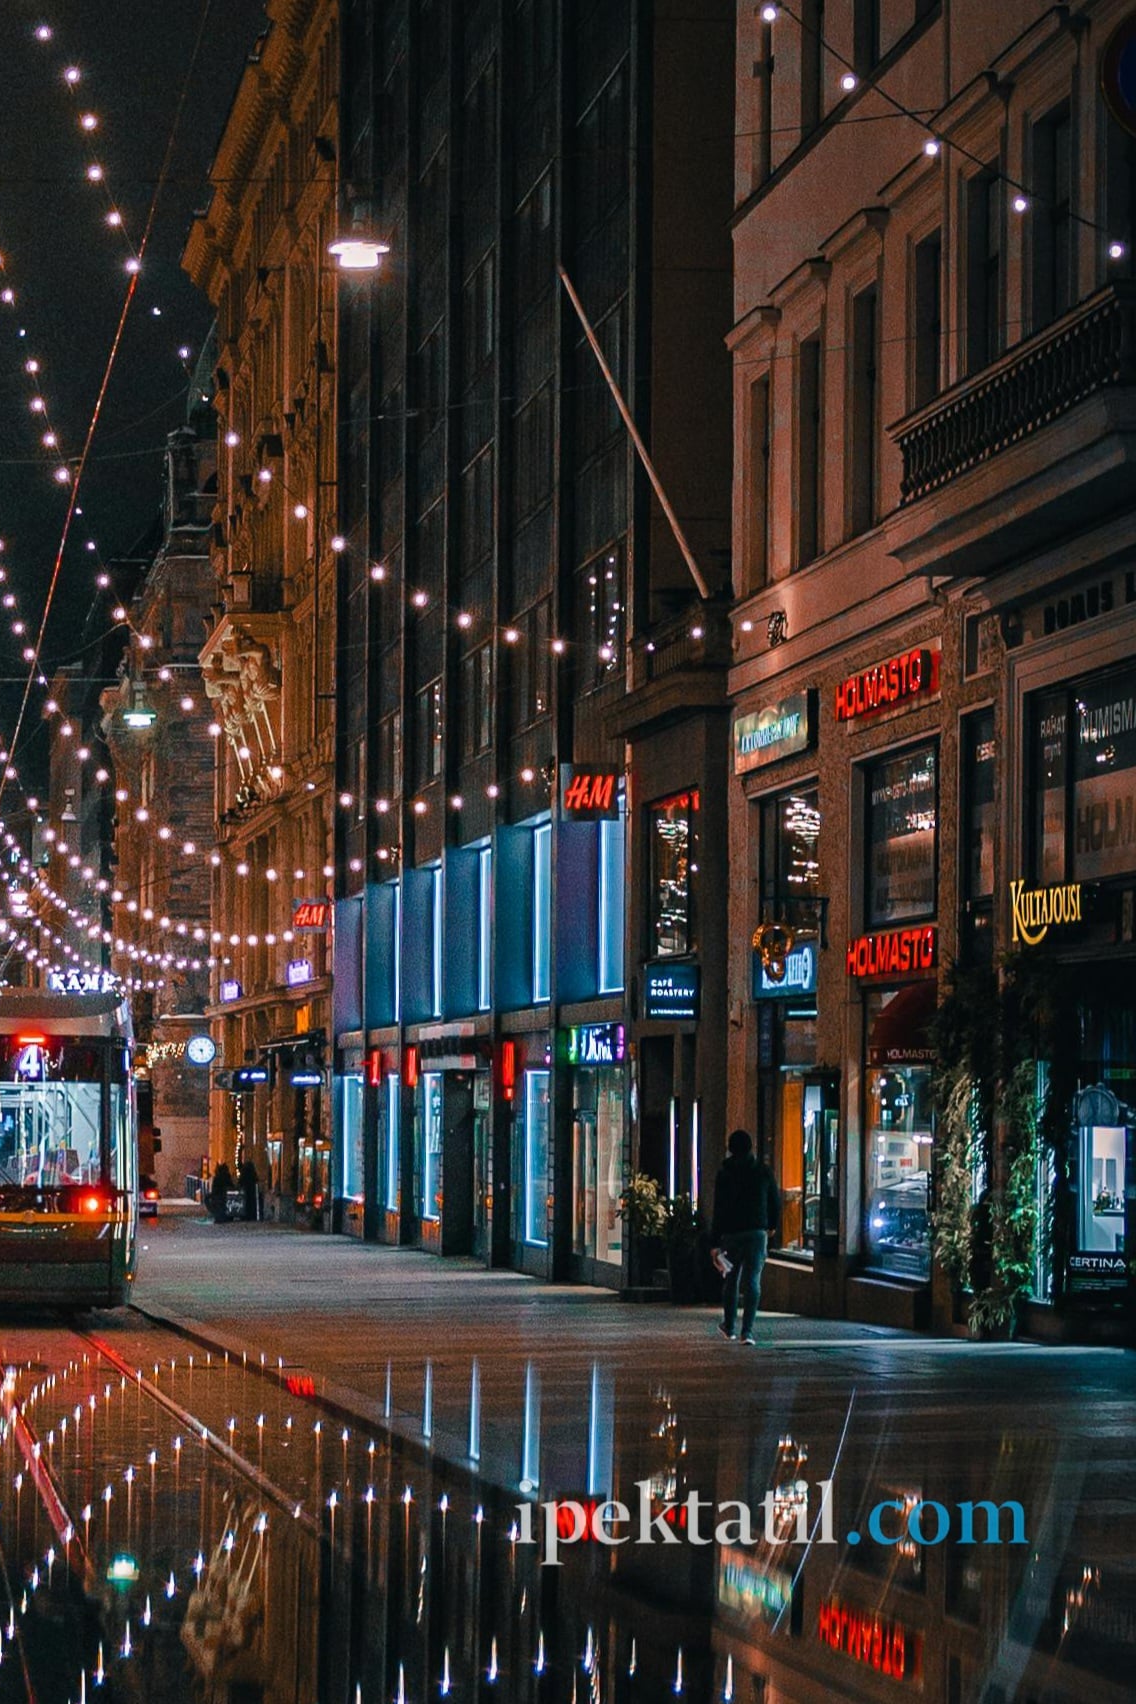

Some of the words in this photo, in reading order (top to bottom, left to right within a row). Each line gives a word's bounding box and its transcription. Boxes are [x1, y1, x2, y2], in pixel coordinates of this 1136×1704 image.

[834, 649, 924, 723] HOLMASTO
[566, 775, 614, 810] H&M
[846, 927, 934, 978] HOLMASTO
[19, 1046, 41, 1078] 4
[1069, 1256, 1127, 1269] CERTINA
